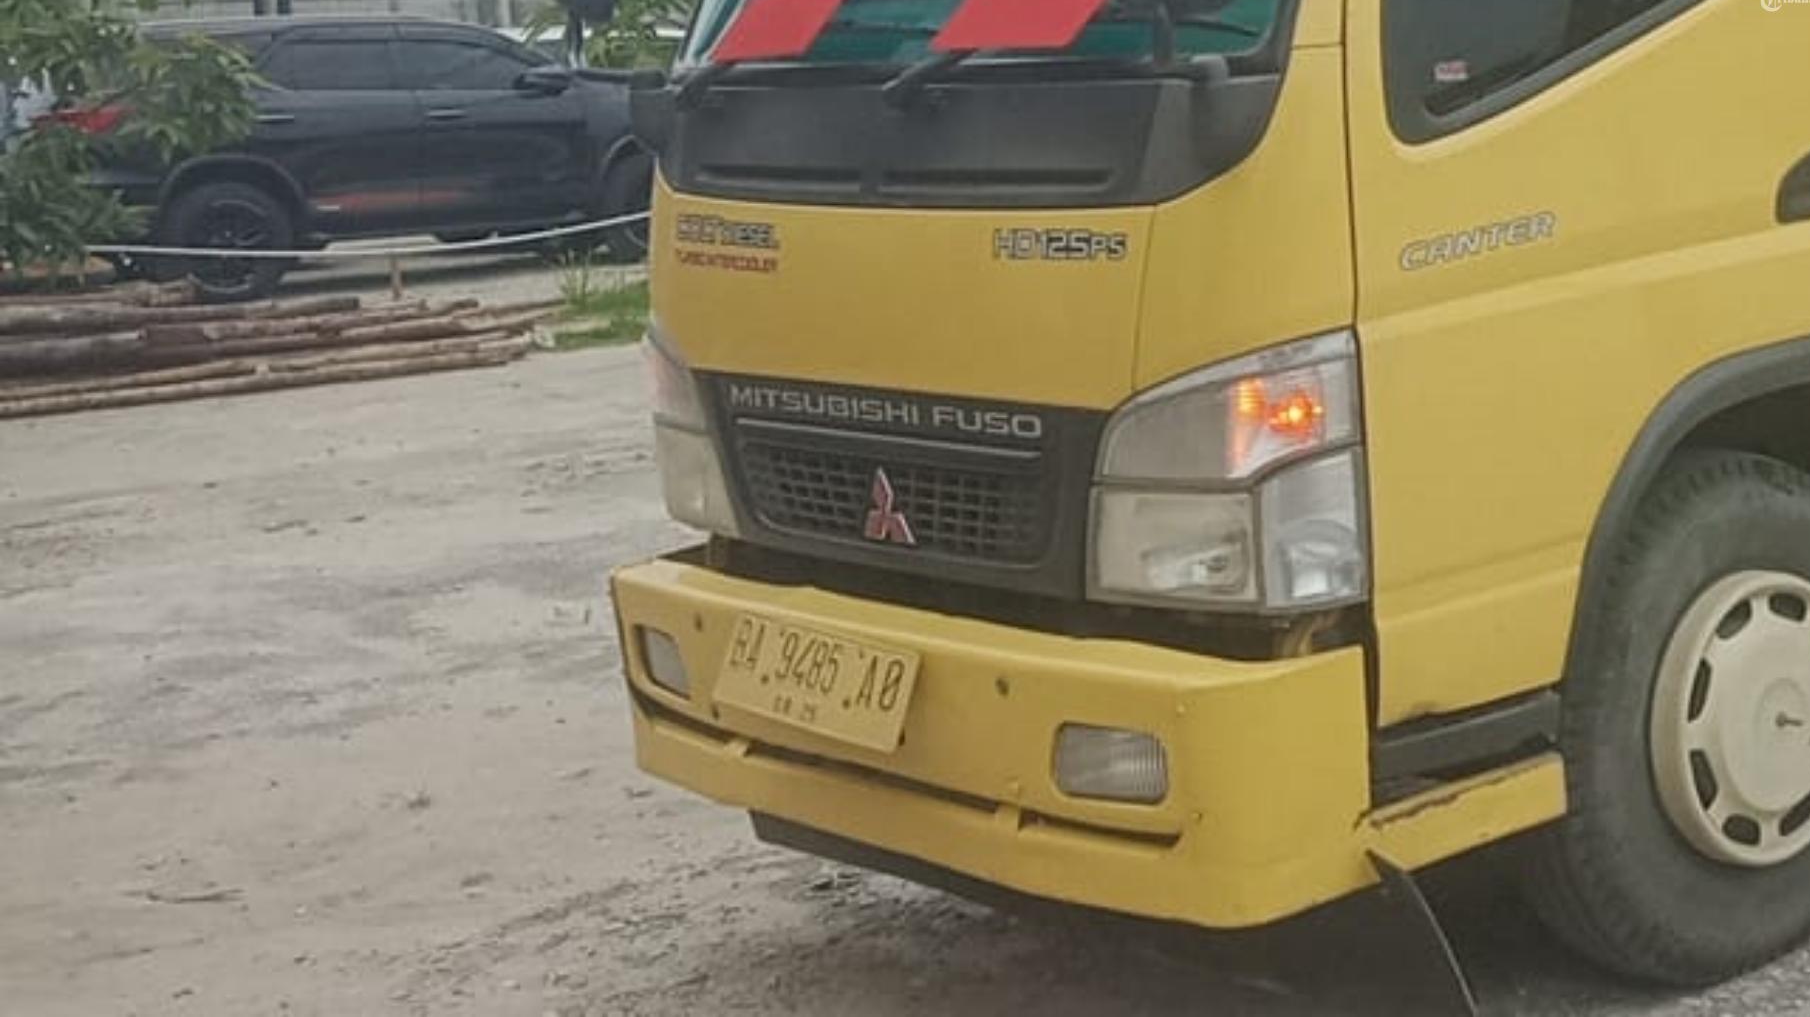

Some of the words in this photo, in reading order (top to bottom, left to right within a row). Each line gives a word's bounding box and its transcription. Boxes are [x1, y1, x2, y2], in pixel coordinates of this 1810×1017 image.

[1399, 211, 1556, 271] CANTER
[730, 385, 919, 425] MITSUBISHI
[931, 405, 1042, 438] FUSO
